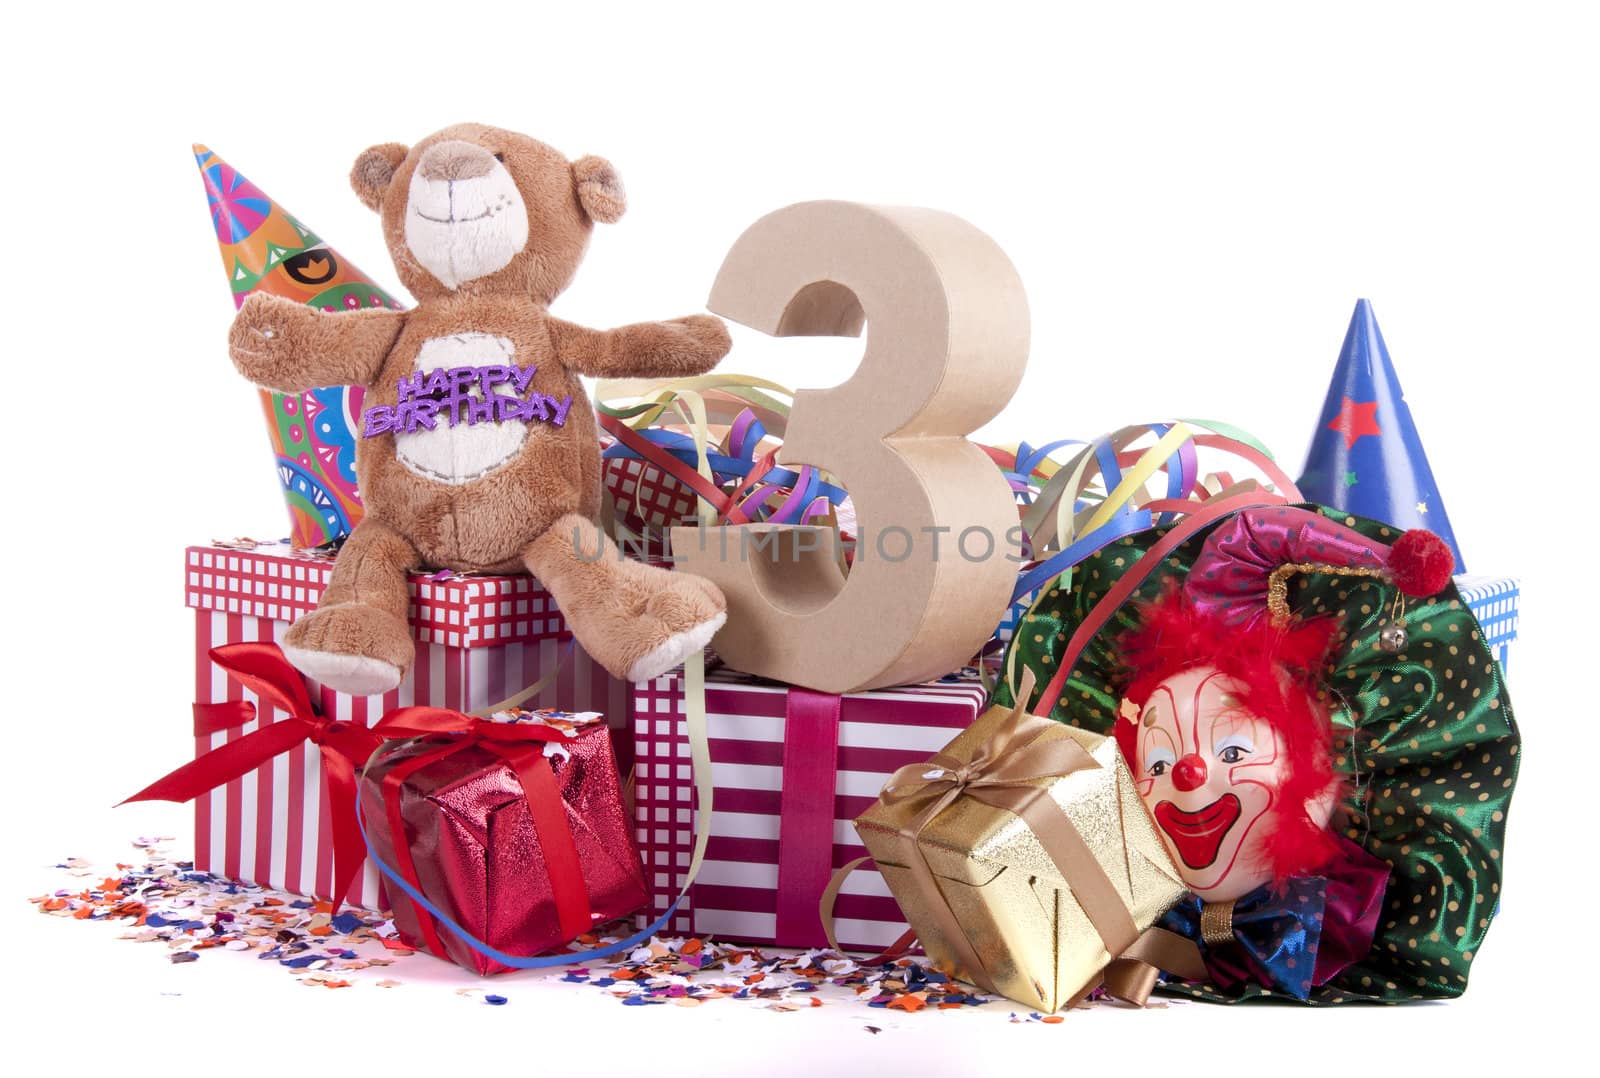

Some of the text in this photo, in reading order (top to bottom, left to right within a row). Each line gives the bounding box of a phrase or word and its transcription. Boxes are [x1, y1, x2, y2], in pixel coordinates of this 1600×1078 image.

[397, 364, 537, 404] HAPPY
[363, 391, 573, 438] BIRTHDAY
[672, 199, 1031, 694] 3
